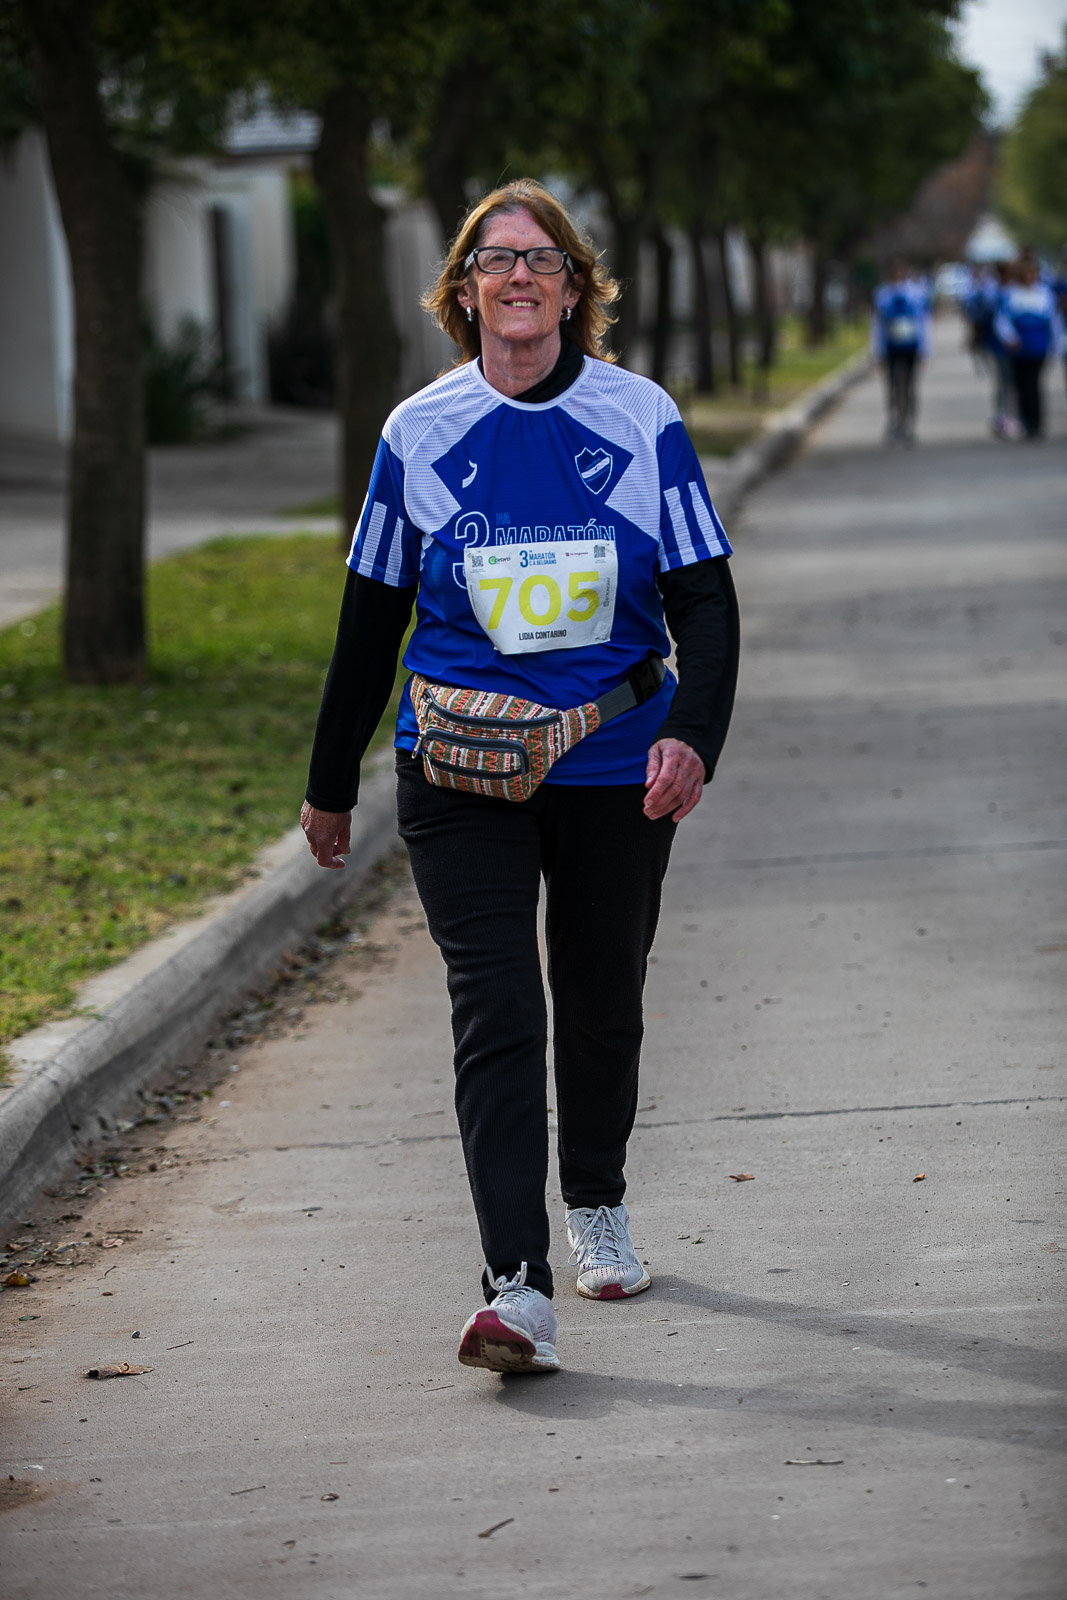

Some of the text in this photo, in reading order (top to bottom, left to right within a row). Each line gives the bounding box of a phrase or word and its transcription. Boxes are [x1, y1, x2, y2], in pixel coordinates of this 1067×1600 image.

[519, 550, 529, 568] 3
[479, 571, 600, 630] 705
[518, 629, 567, 641] LIDIA CONTARINO
